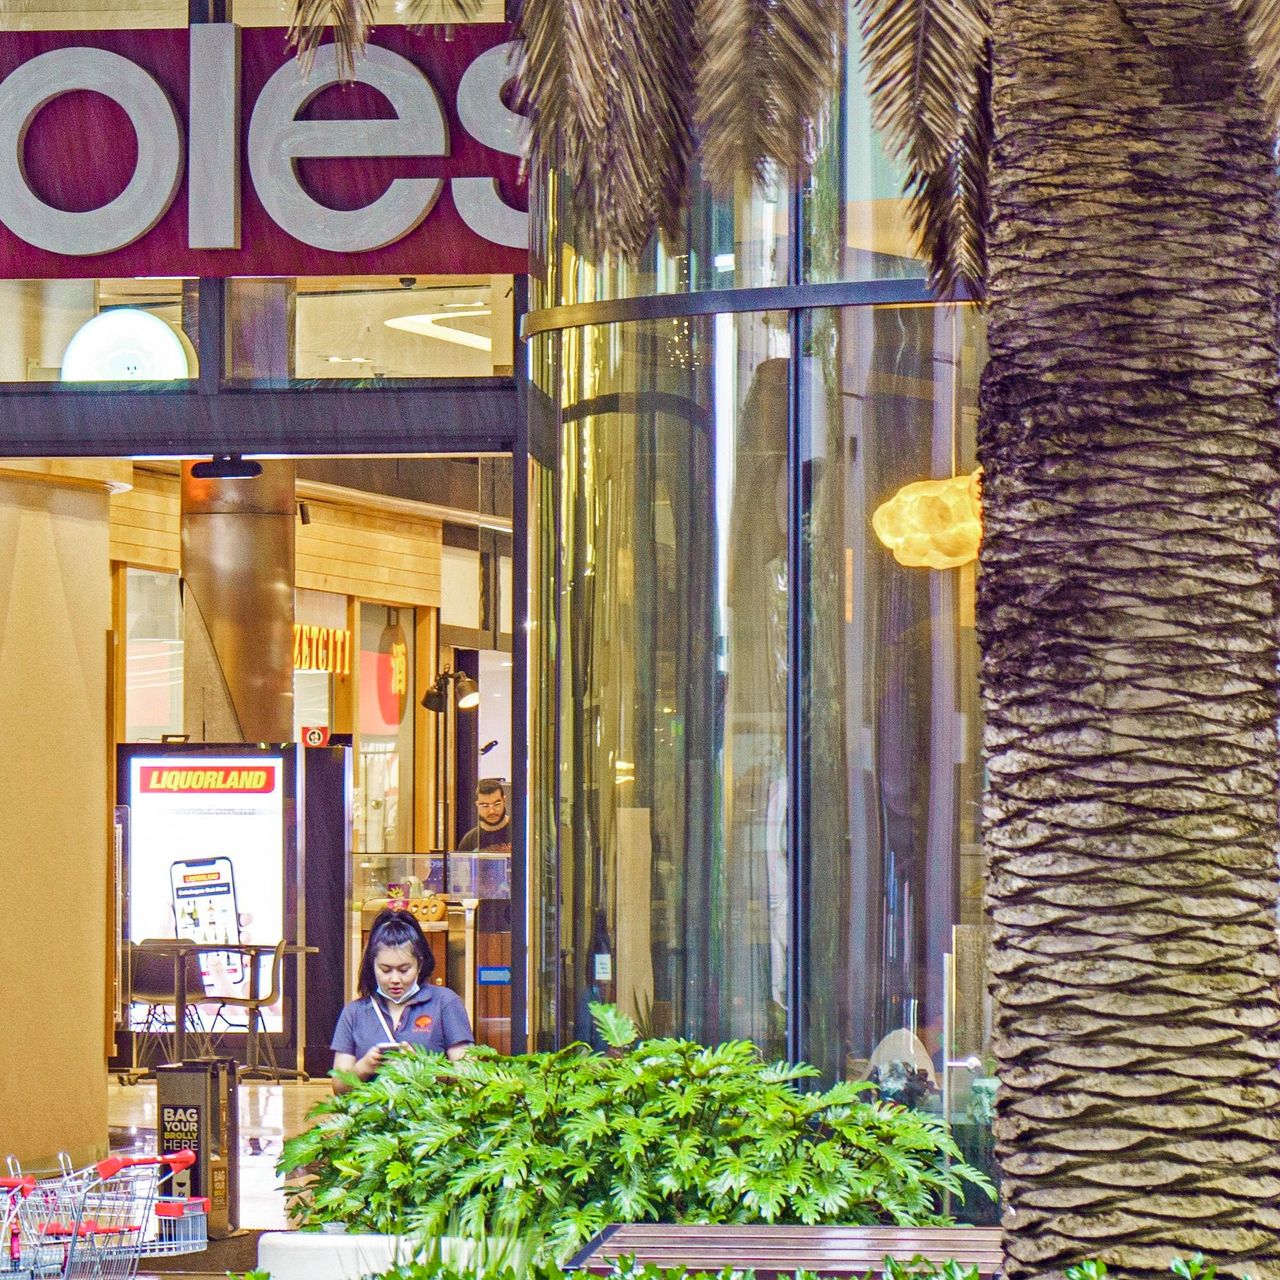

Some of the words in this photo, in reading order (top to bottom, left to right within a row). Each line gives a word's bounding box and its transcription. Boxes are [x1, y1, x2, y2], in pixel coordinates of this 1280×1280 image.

[149, 770, 267, 791] LIQUORLAND
[163, 1108, 198, 1121] BAG
[164, 1122, 198, 1131] YOUR
[163, 1140, 199, 1150] HERE
